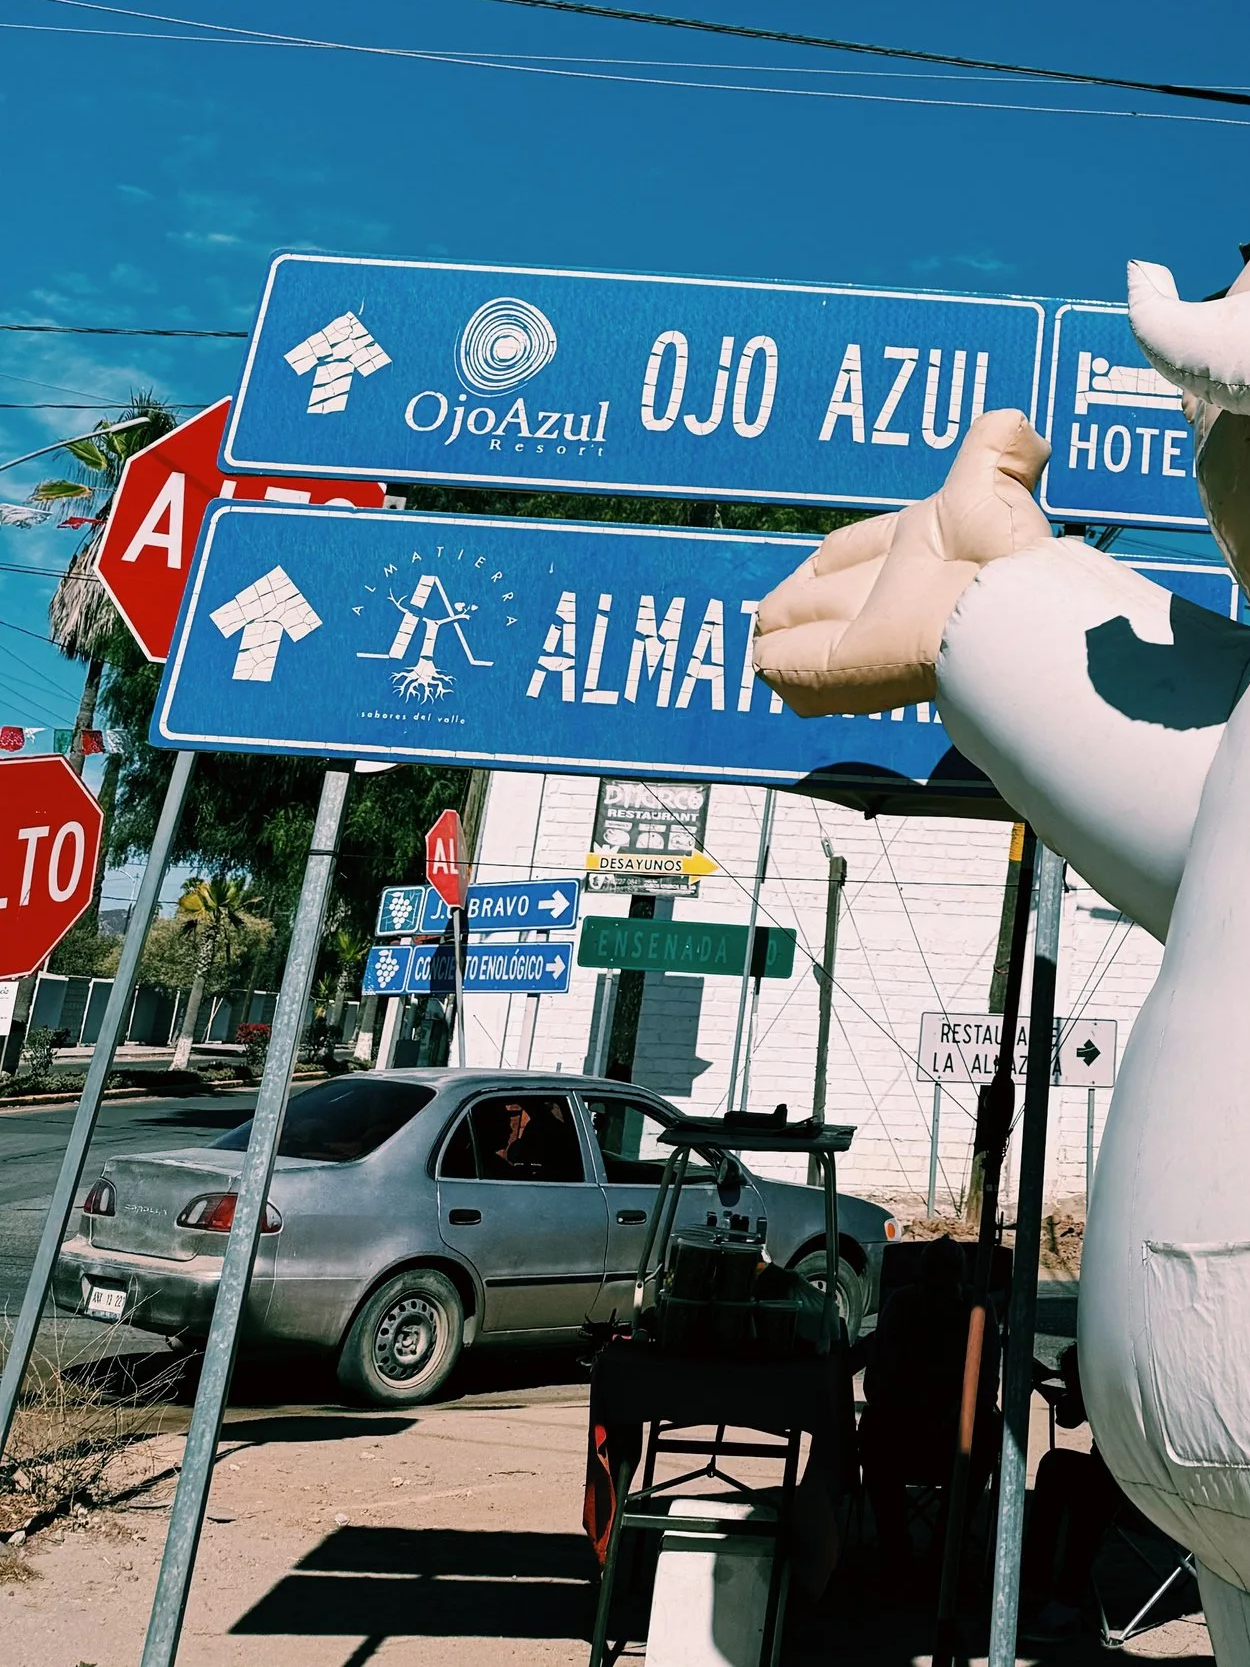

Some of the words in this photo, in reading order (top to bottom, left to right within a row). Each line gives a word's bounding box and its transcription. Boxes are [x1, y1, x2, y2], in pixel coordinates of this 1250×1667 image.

[642, 331, 778, 438] OJO
[405, 391, 610, 446] OjoAzul
[489, 439, 604, 456] Resort
[1069, 422, 1197, 478] HOTE
[352, 546, 517, 627] ALMATIERRA
[361, 711, 407, 720] sabores
[413, 713, 431, 722] del
[437, 716, 466, 725] valle
[607, 808, 700, 822] RESTAURANT
[0, 821, 85, 906] TO
[600, 857, 682, 871] DESAYUNOS
[468, 895, 529, 918] BRAVO
[598, 929, 727, 964] ENSENADA
[414, 954, 478, 981] CONCIETO
[479, 948, 544, 981] ENOLÓGICO
[932, 1051, 954, 1073] LA
